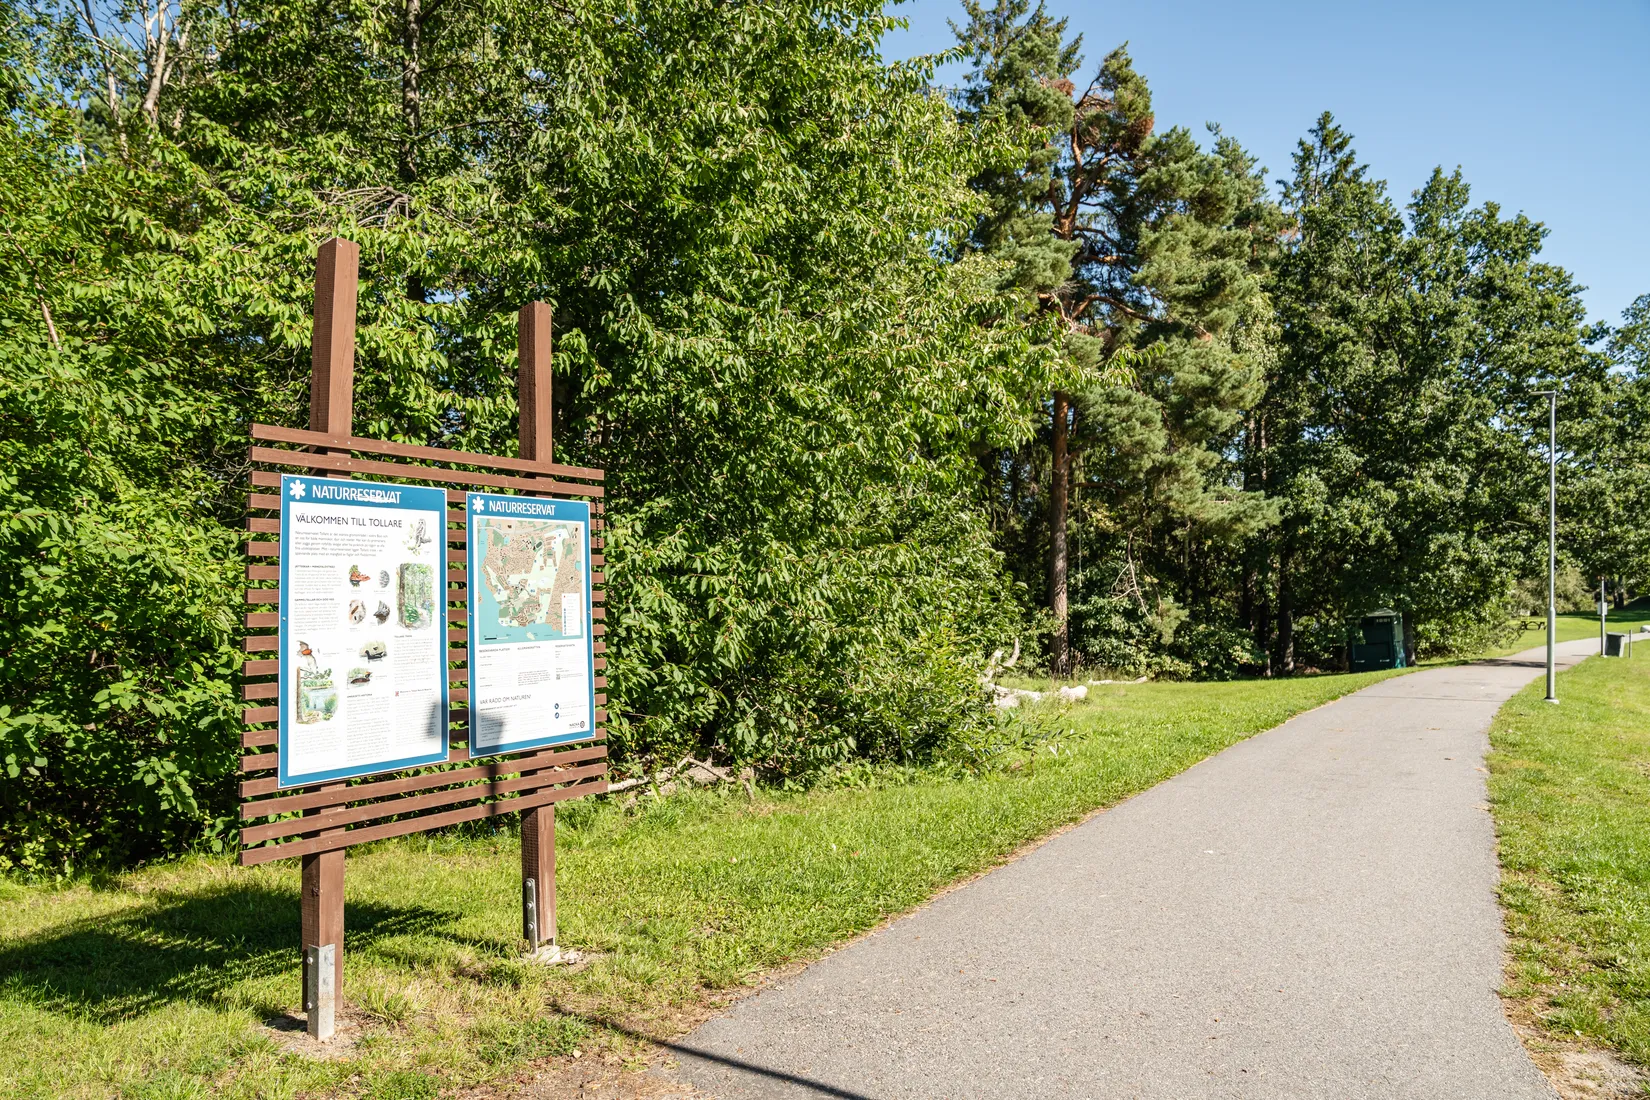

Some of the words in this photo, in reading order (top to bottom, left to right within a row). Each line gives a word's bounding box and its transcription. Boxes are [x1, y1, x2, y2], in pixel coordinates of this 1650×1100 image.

[312, 484, 402, 504] NATURRESERVAT
[489, 500, 556, 516] NATURRESERVAT
[295, 512, 349, 525] VÄLKOMMEN
[351, 517, 367, 526] TILL
[368, 518, 402, 528] TOLLARE
